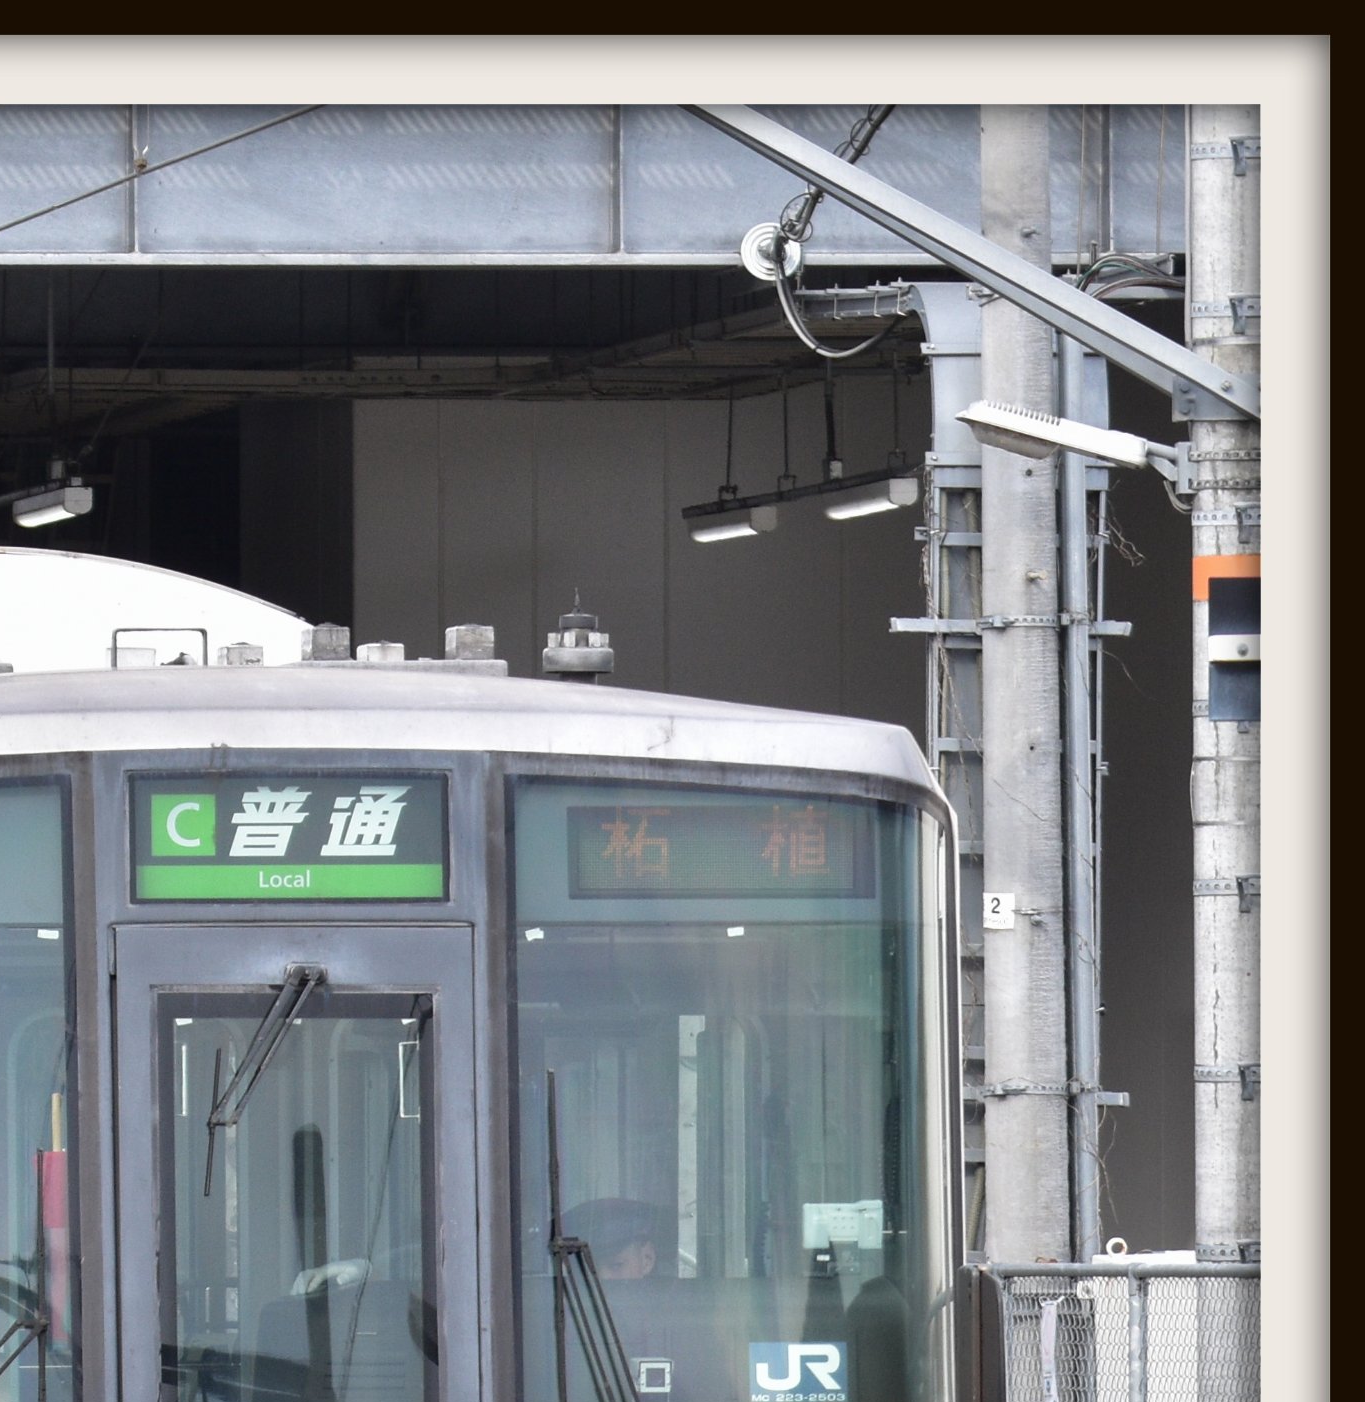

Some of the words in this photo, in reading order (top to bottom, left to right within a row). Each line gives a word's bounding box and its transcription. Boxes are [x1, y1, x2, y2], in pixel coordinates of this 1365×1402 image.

[166, 801, 201, 848] C
[228, 785, 413, 858] 普通
[258, 870, 311, 889] Local
[990, 896, 1001, 914] 2
[755, 1344, 842, 1391] JR
[775, 1393, 846, 1402] 223-2503
